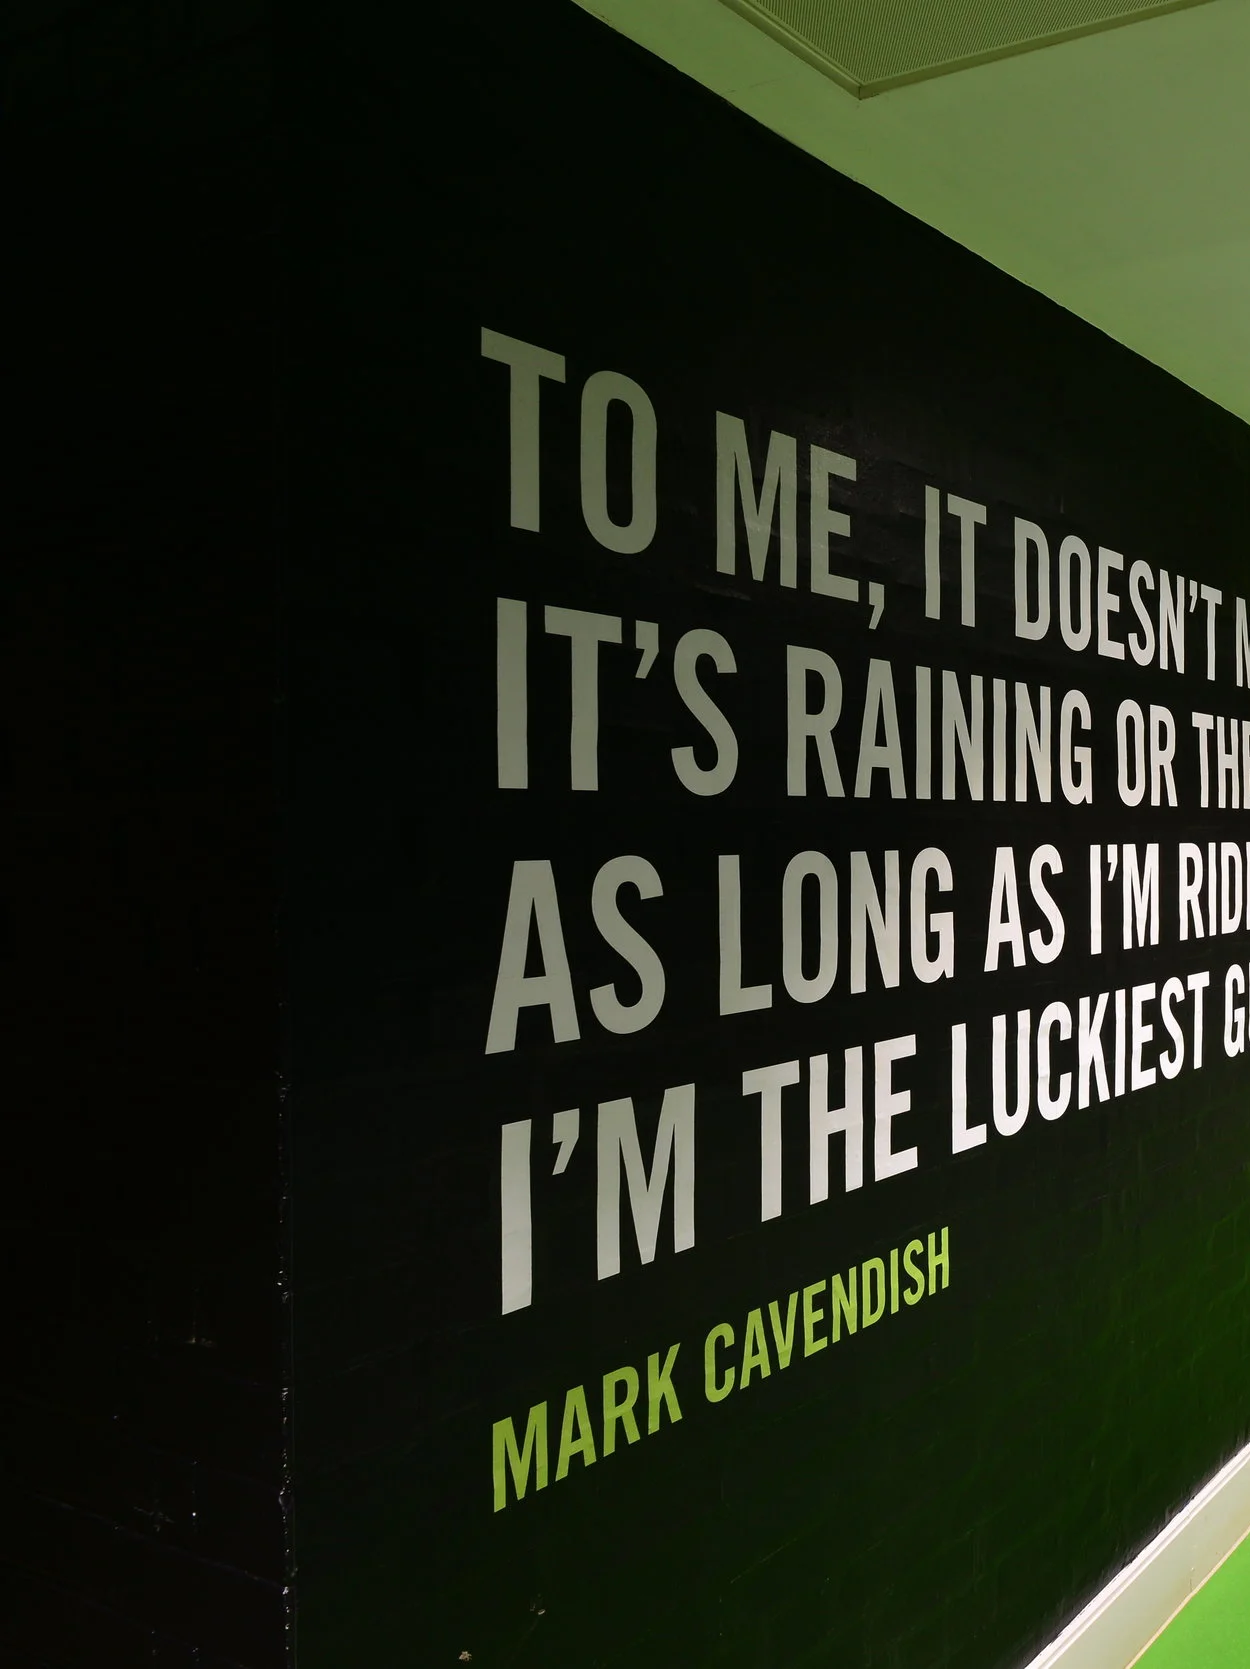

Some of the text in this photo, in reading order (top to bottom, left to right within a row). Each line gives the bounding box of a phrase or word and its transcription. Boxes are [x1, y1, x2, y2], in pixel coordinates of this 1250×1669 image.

[482, 327, 657, 553] TO
[717, 411, 885, 629] ME,
[925, 485, 986, 627] IT
[1015, 517, 1222, 681] DOESN'T
[497, 598, 738, 796] IT'S
[787, 645, 1092, 805] RAINING
[1117, 699, 1178, 807] OR
[485, 856, 665, 1054] AS
[719, 847, 954, 1015] LONG
[984, 844, 1065, 972] AS
[1090, 843, 1159, 955] I'M
[501, 1083, 695, 1315] I'M
[742, 1034, 918, 1222] THE
[952, 971, 1210, 1154] LUCKIEST
[493, 1226, 949, 1512] MARK CAVENDISH
